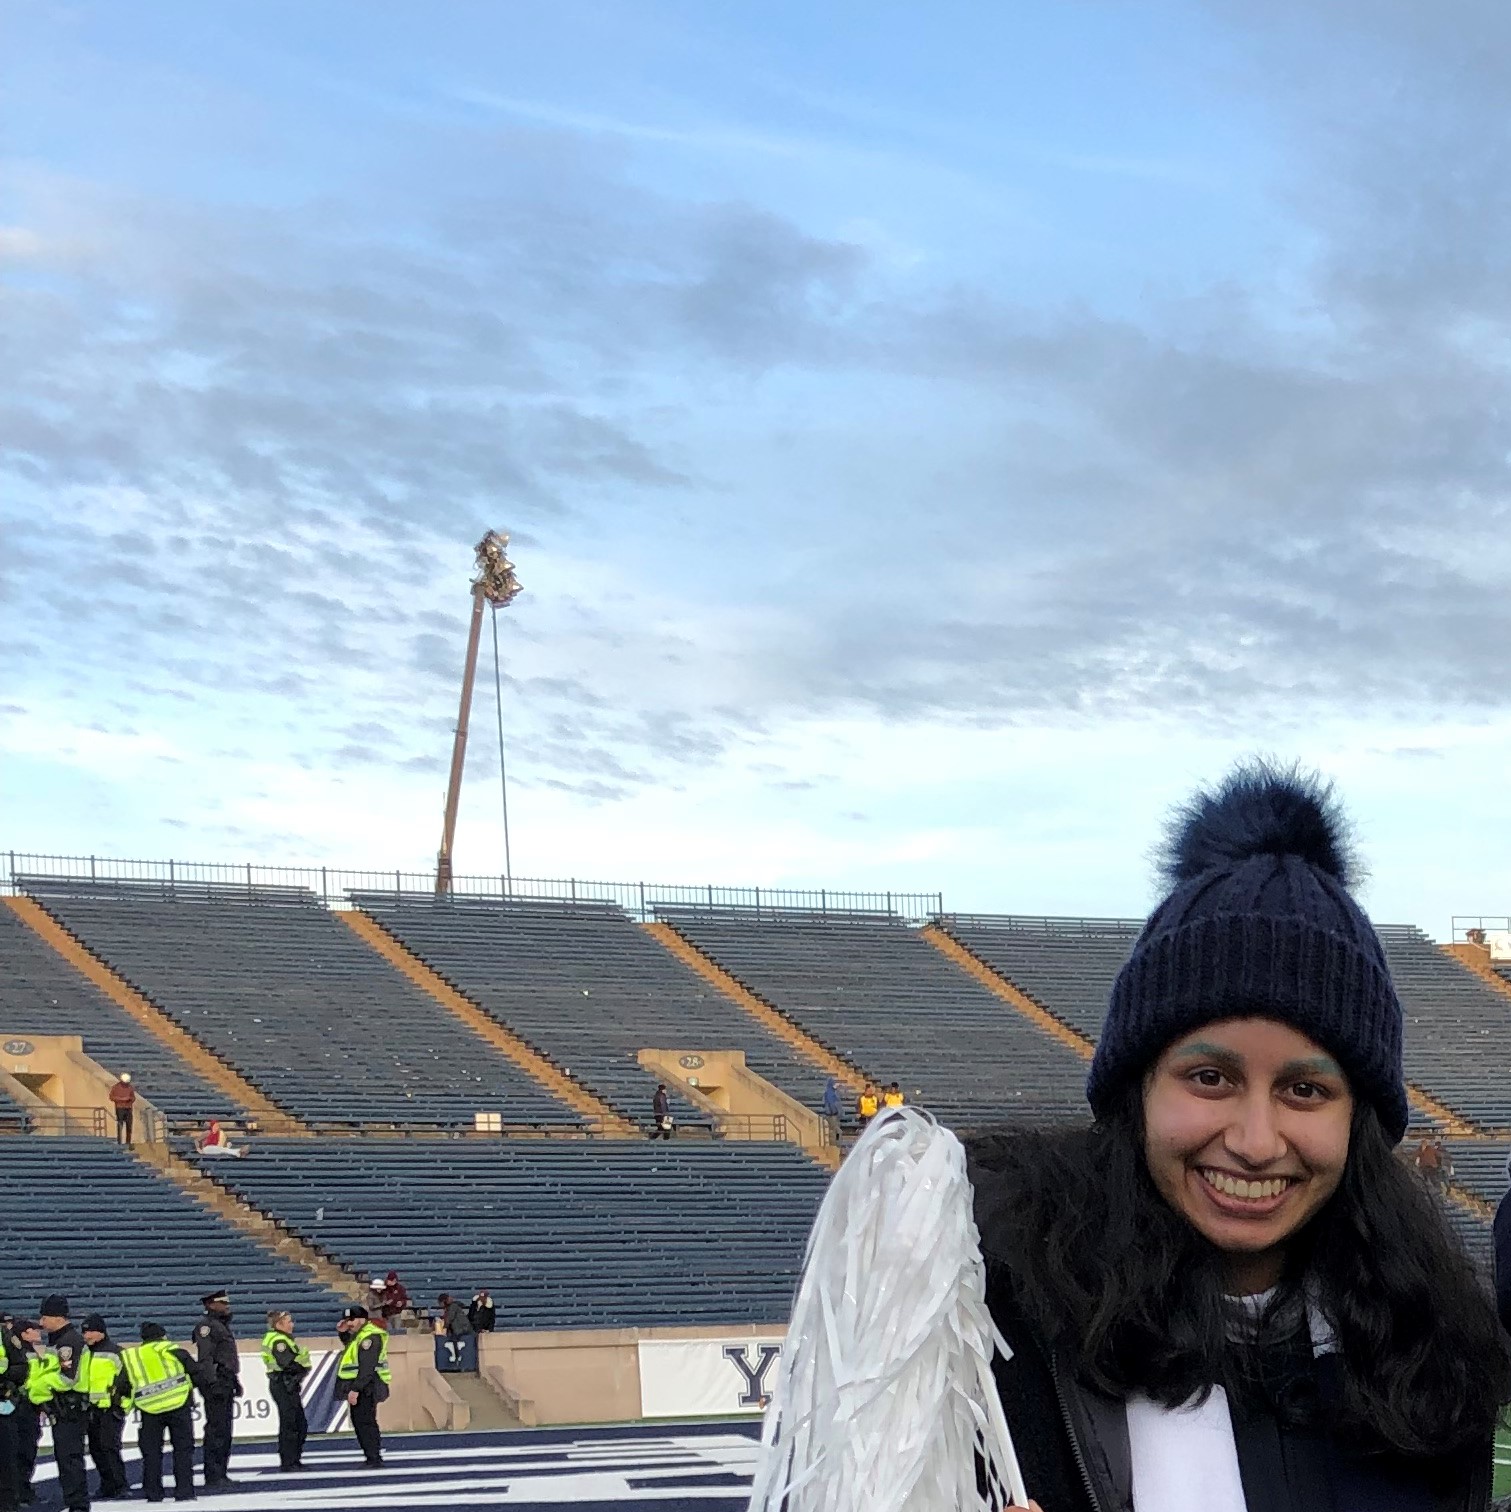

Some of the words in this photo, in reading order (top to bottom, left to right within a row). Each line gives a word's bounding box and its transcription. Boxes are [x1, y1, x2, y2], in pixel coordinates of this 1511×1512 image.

[12, 1042, 26, 1053] 27
[686, 1056, 699, 1067] 28
[444, 1341, 466, 1362] Y
[723, 1343, 783, 1408] Y
[232, 1398, 271, 1420] 019
